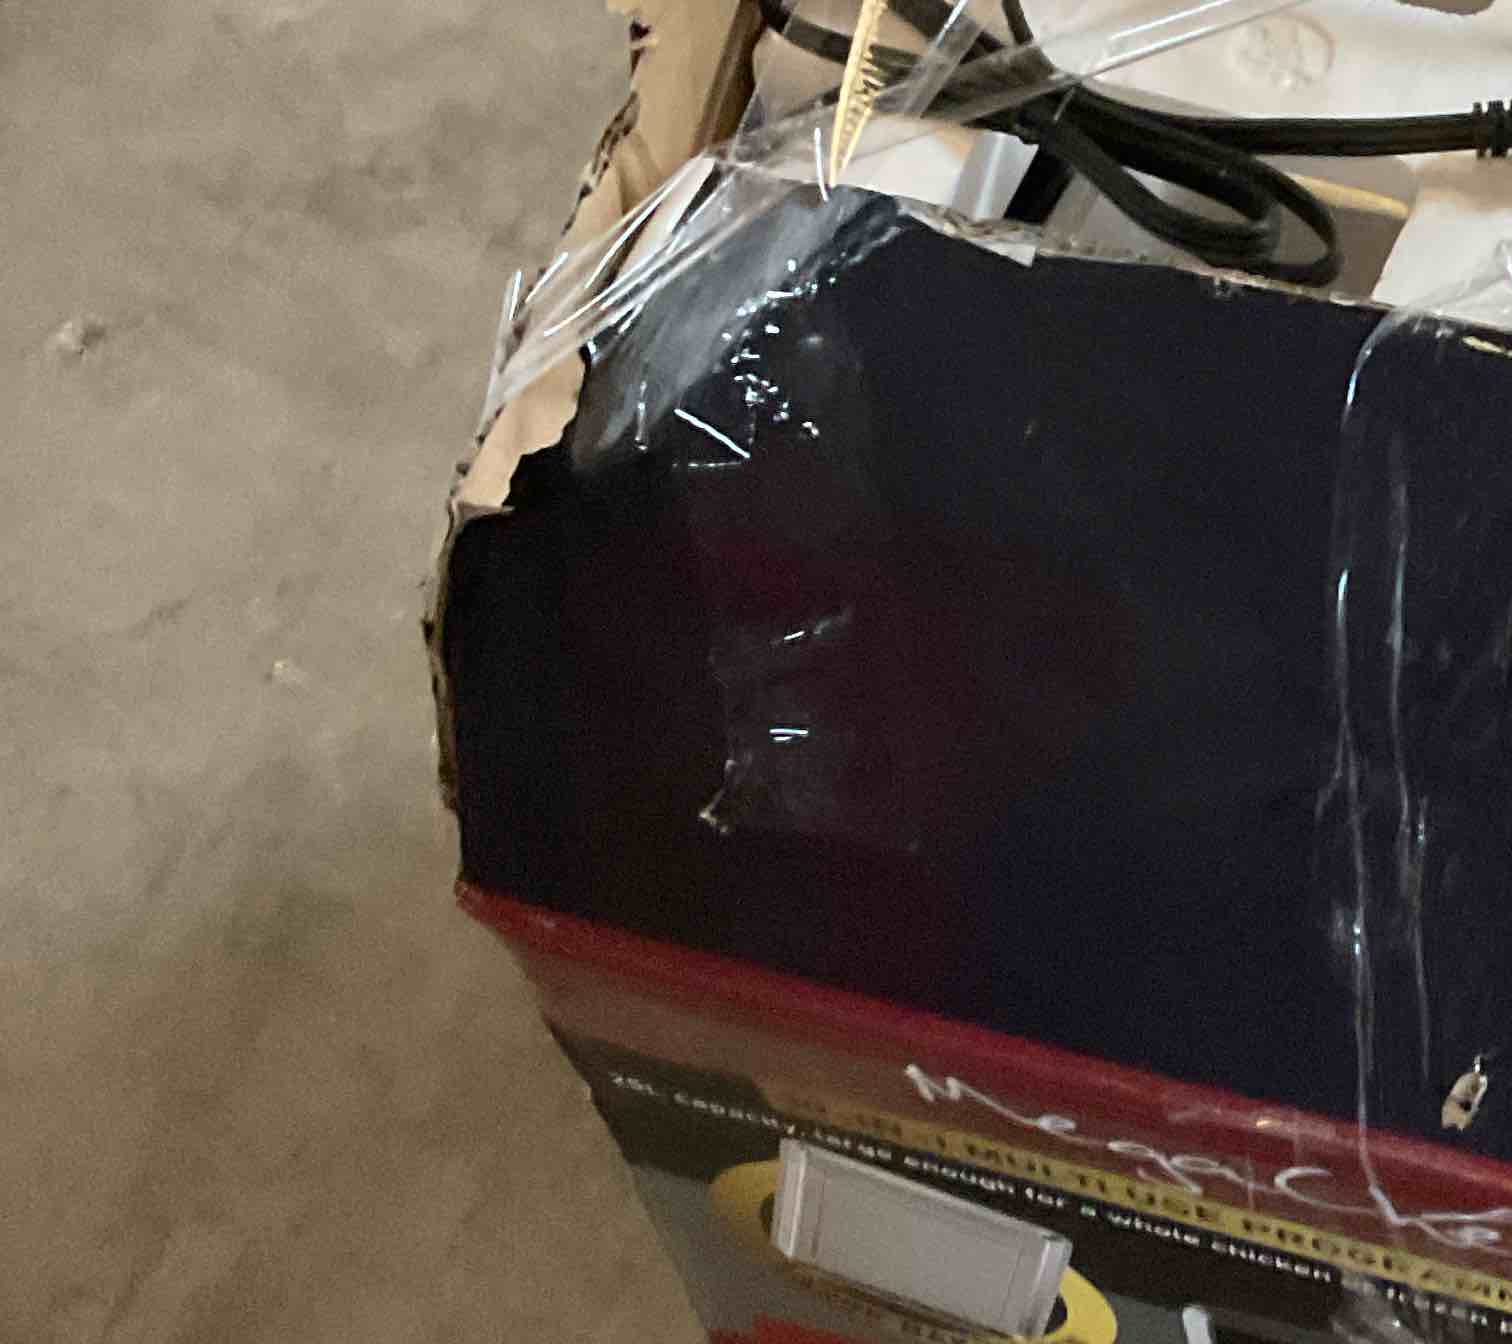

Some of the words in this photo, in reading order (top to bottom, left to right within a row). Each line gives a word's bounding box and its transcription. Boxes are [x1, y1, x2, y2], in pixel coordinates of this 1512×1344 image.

[813, 1127, 895, 1163] large
[901, 1154, 1017, 1199] enough
[1023, 1186, 1066, 1209] for
[1080, 1204, 1098, 1219] a
[1106, 1210, 1201, 1247] whole
[1210, 1239, 1334, 1284] chicken
